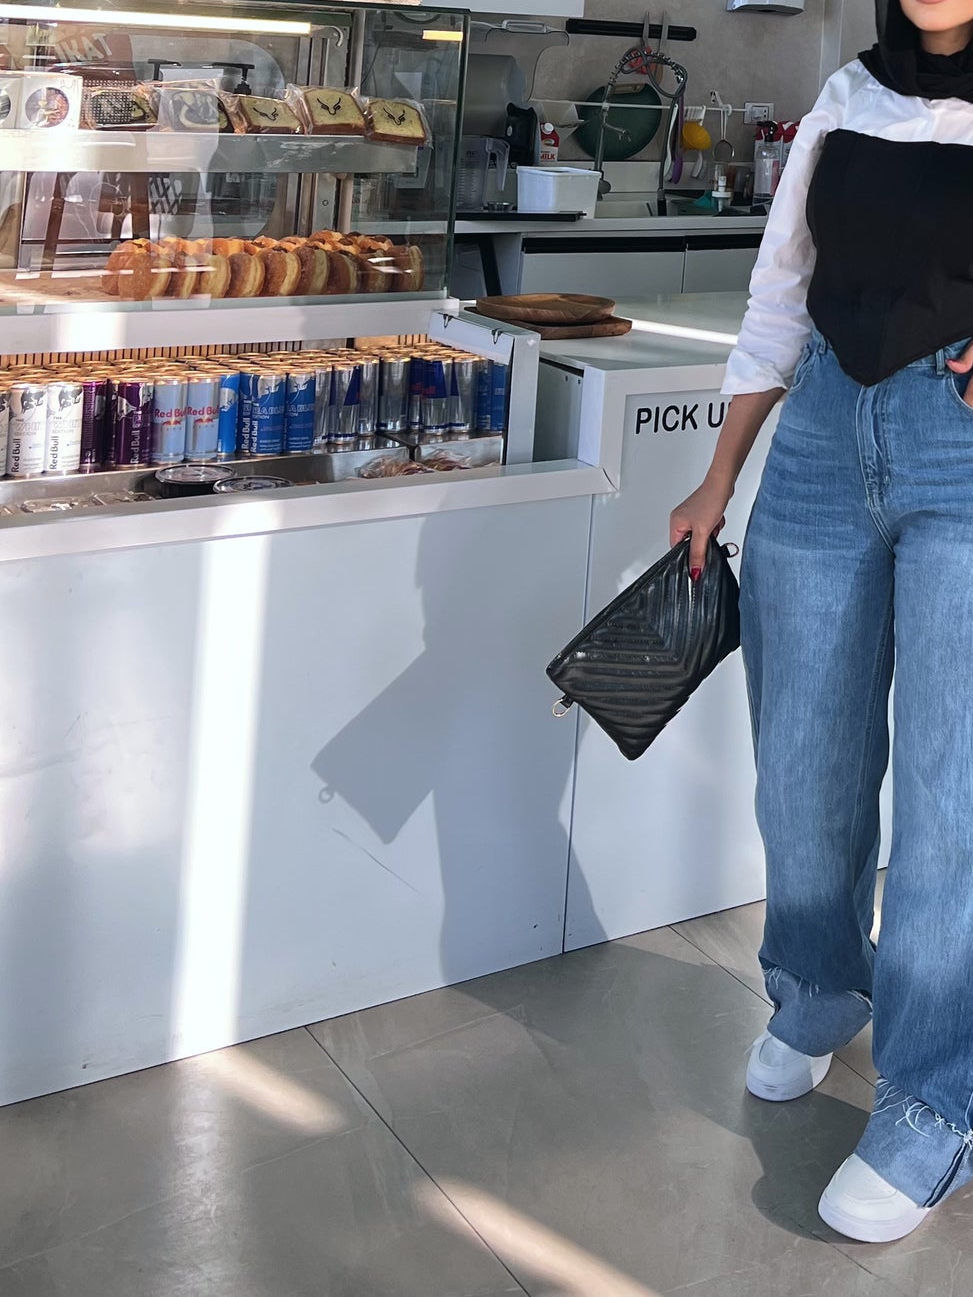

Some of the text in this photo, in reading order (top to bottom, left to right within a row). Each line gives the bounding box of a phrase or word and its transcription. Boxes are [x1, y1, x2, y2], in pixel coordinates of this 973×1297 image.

[54, 33, 112, 62] IKAT
[154, 408, 172, 418] Red
[187, 406, 205, 416] Red
[635, 401, 731, 434] PICK U
[130, 430, 140, 447] Bull
[241, 417, 250, 450] Red Bull
[11, 438, 21, 473] Red Bull
[49, 435, 59, 470] Red Bull
